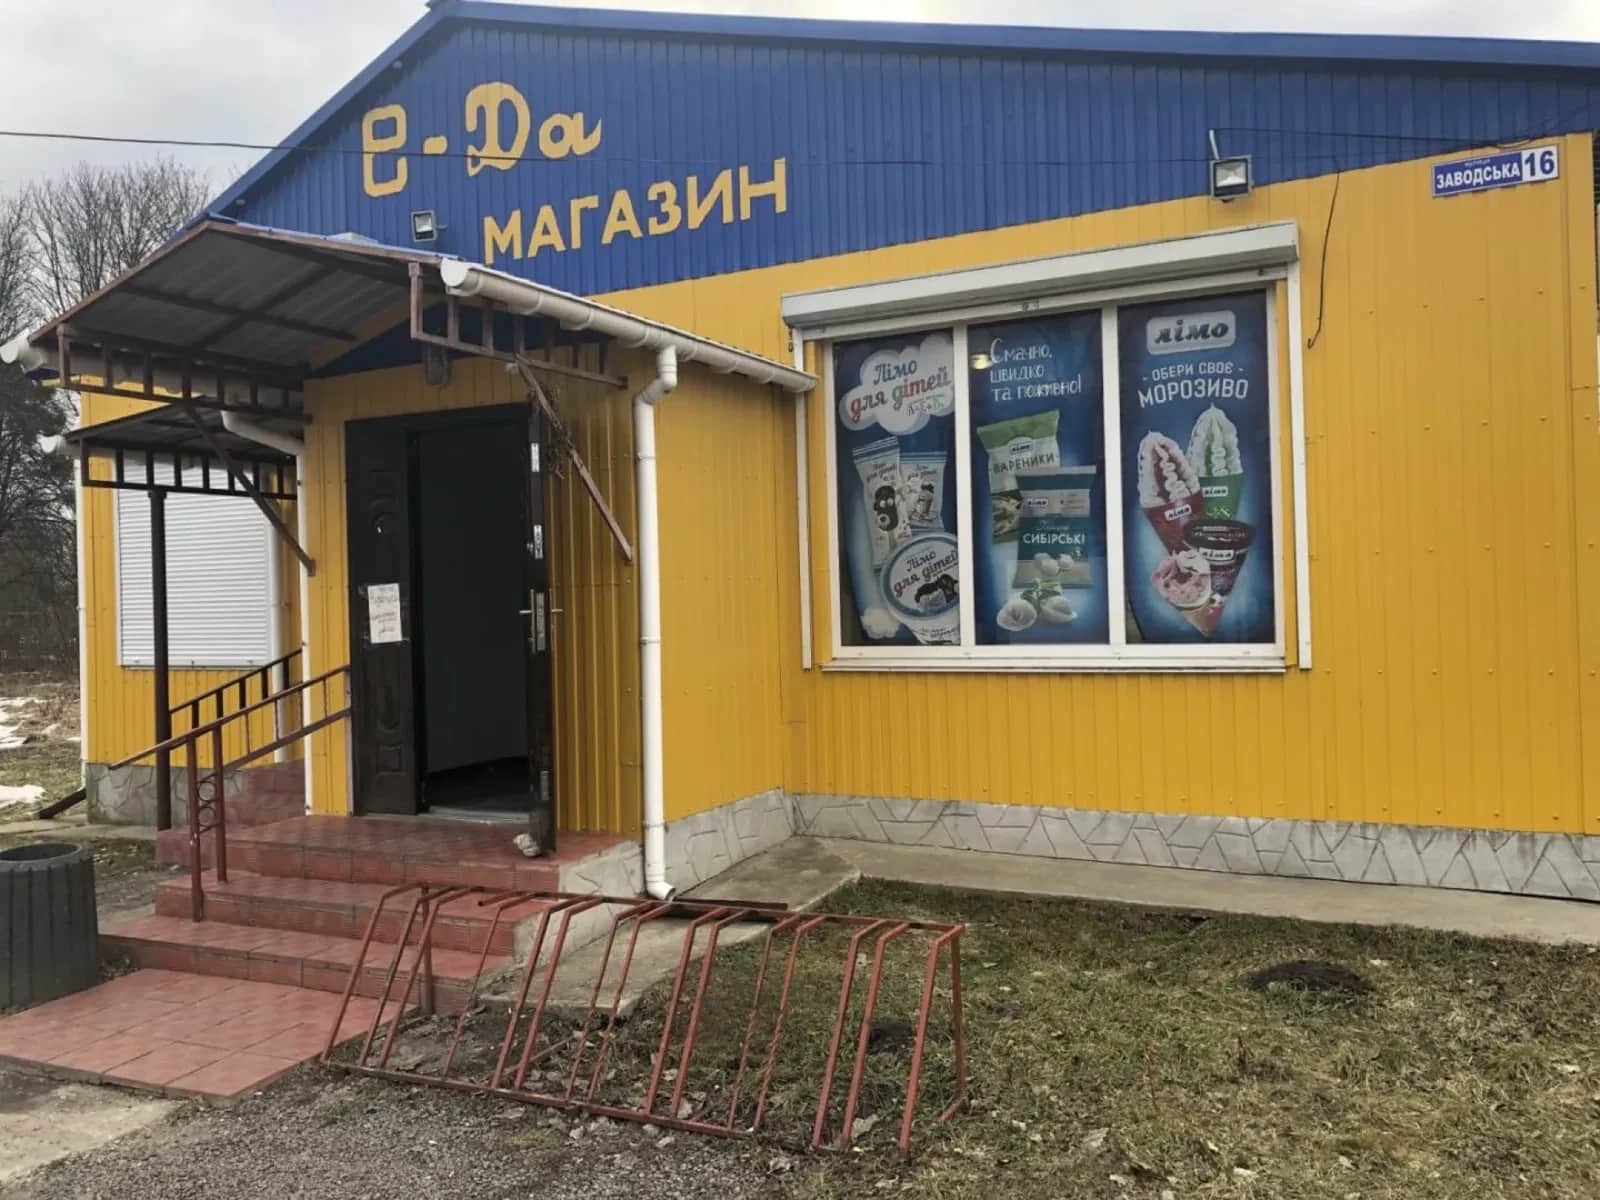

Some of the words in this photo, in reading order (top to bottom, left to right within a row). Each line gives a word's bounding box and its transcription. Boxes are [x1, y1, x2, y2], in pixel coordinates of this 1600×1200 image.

[1436, 162, 1521, 189] ЗАВОДСЬКА
[1524, 150, 1555, 177] 16
[483, 157, 787, 265] МАГАЗИН
[1155, 319, 1229, 344] лімо
[873, 360, 918, 385] Лімо
[1151, 363, 1194, 381] ОБЕРИ
[1198, 361, 1234, 374] СВОЄ
[850, 391, 888, 423] для
[892, 366, 952, 411] дітей
[991, 387, 1011, 401] та
[1137, 378, 1249, 408] МОРОЗИВО
[1023, 533, 1085, 545] СИБІРСЬКІ
